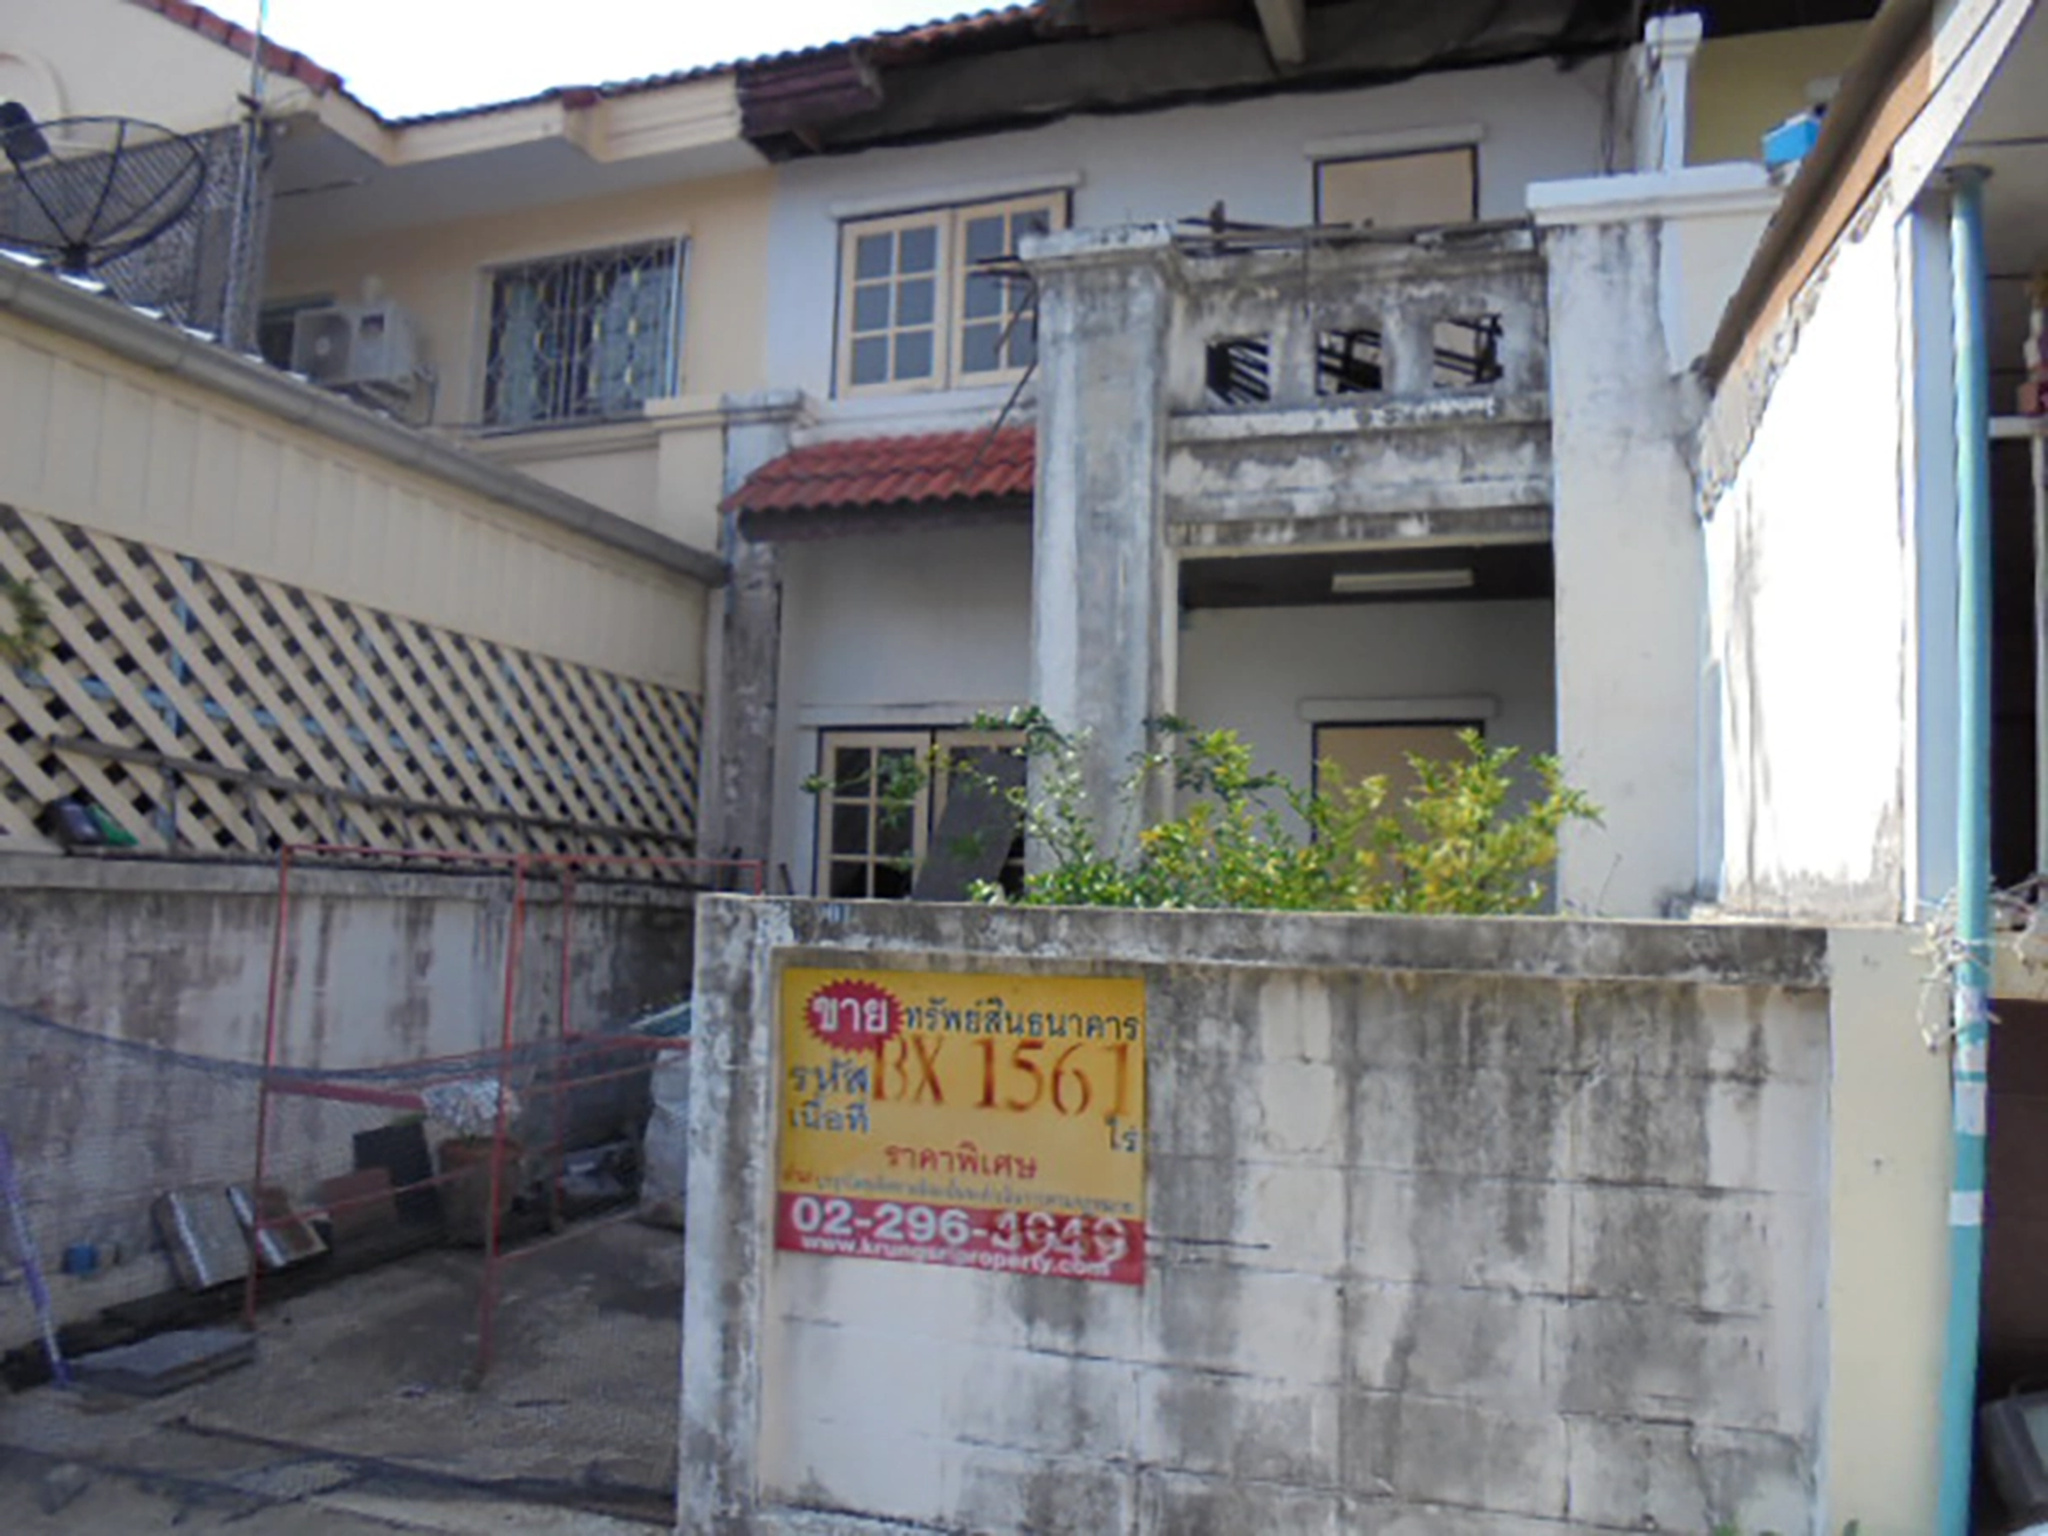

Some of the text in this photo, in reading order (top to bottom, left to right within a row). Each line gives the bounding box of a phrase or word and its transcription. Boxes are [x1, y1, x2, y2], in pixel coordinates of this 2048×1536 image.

[810, 996, 891, 1034] ขาย
[974, 1037, 1131, 1118] 1561
[884, 1140, 1037, 1180] ราคาพิเศษ
